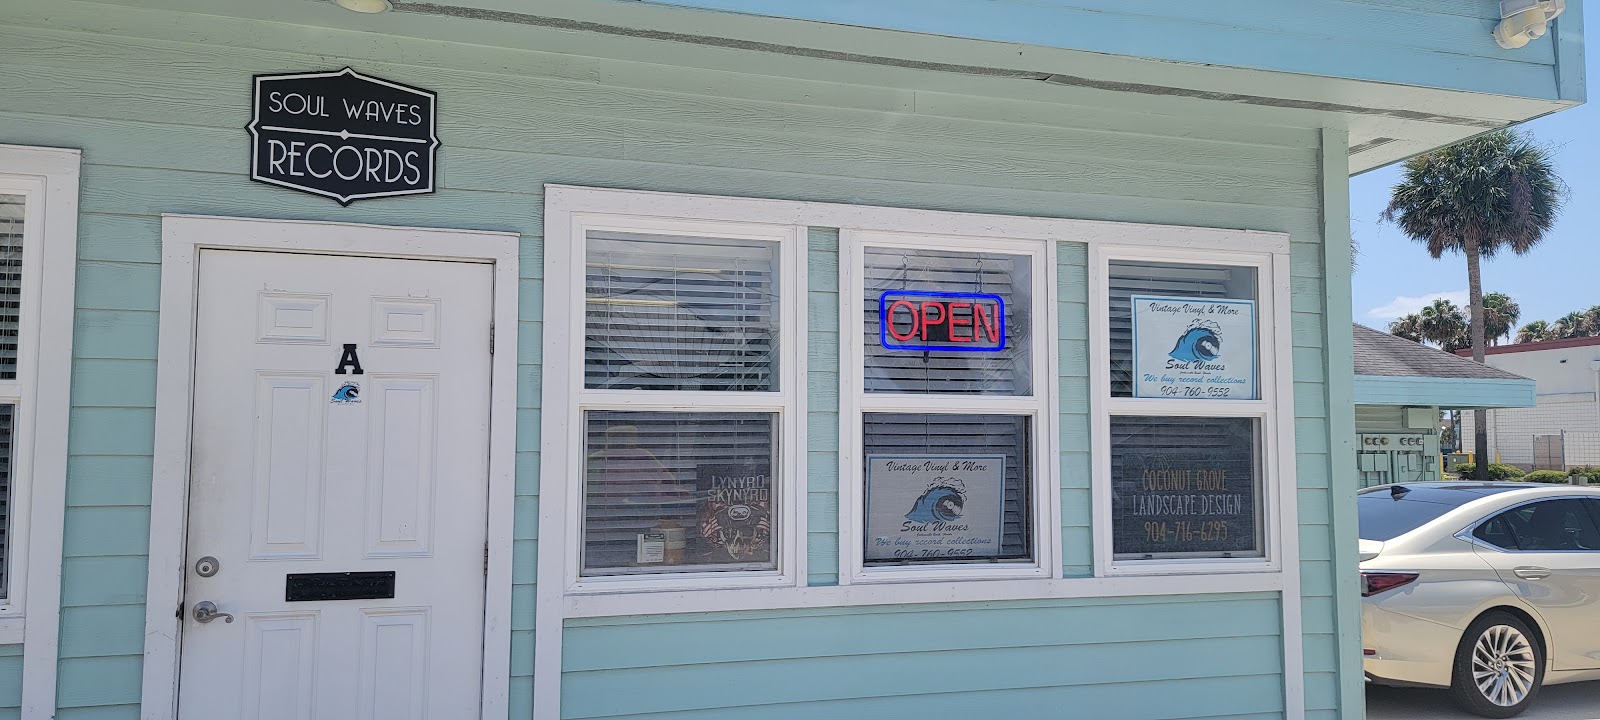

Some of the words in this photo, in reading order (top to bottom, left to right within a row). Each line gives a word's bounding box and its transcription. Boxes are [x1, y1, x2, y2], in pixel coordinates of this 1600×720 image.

[268, 91, 330, 118] SOUL
[342, 98, 422, 126] WAVES
[267, 139, 421, 186] RECORDS
[1150, 302, 1181, 315] Vintage
[1183, 304, 1206, 316] Vinyl
[1208, 305, 1215, 314] &
[1216, 305, 1239, 316] More
[887, 299, 999, 343] OPEN
[335, 344, 364, 374] A
[1165, 359, 1189, 370] Soul
[1192, 360, 1225, 371] Waves
[1143, 373, 1158, 382] We
[1160, 374, 1175, 385] buy
[1178, 375, 1204, 384] record
[1206, 375, 1247, 385] collections
[1161, 386, 1230, 396] 904-760-9552
[886, 461, 922, 474] Vintage
[924, 461, 949, 474] Vinyl
[952, 461, 960, 471] &
[962, 461, 988, 472] More
[712, 475, 765, 489] LYNYRD
[1143, 470, 1191, 491] COCONUT
[1197, 470, 1227, 491] GROVE
[707, 488, 768, 505] SKYNYRD
[1133, 495, 1197, 515] LANDSCAPE
[1201, 494, 1241, 514] DESIGN
[901, 521, 928, 532] Soul
[932, 521, 970, 532] Waves
[1145, 522, 1228, 541] 904-716-6295
[875, 537, 892, 546] We
[895, 537, 911, 548] buy
[915, 537, 943, 545] record
